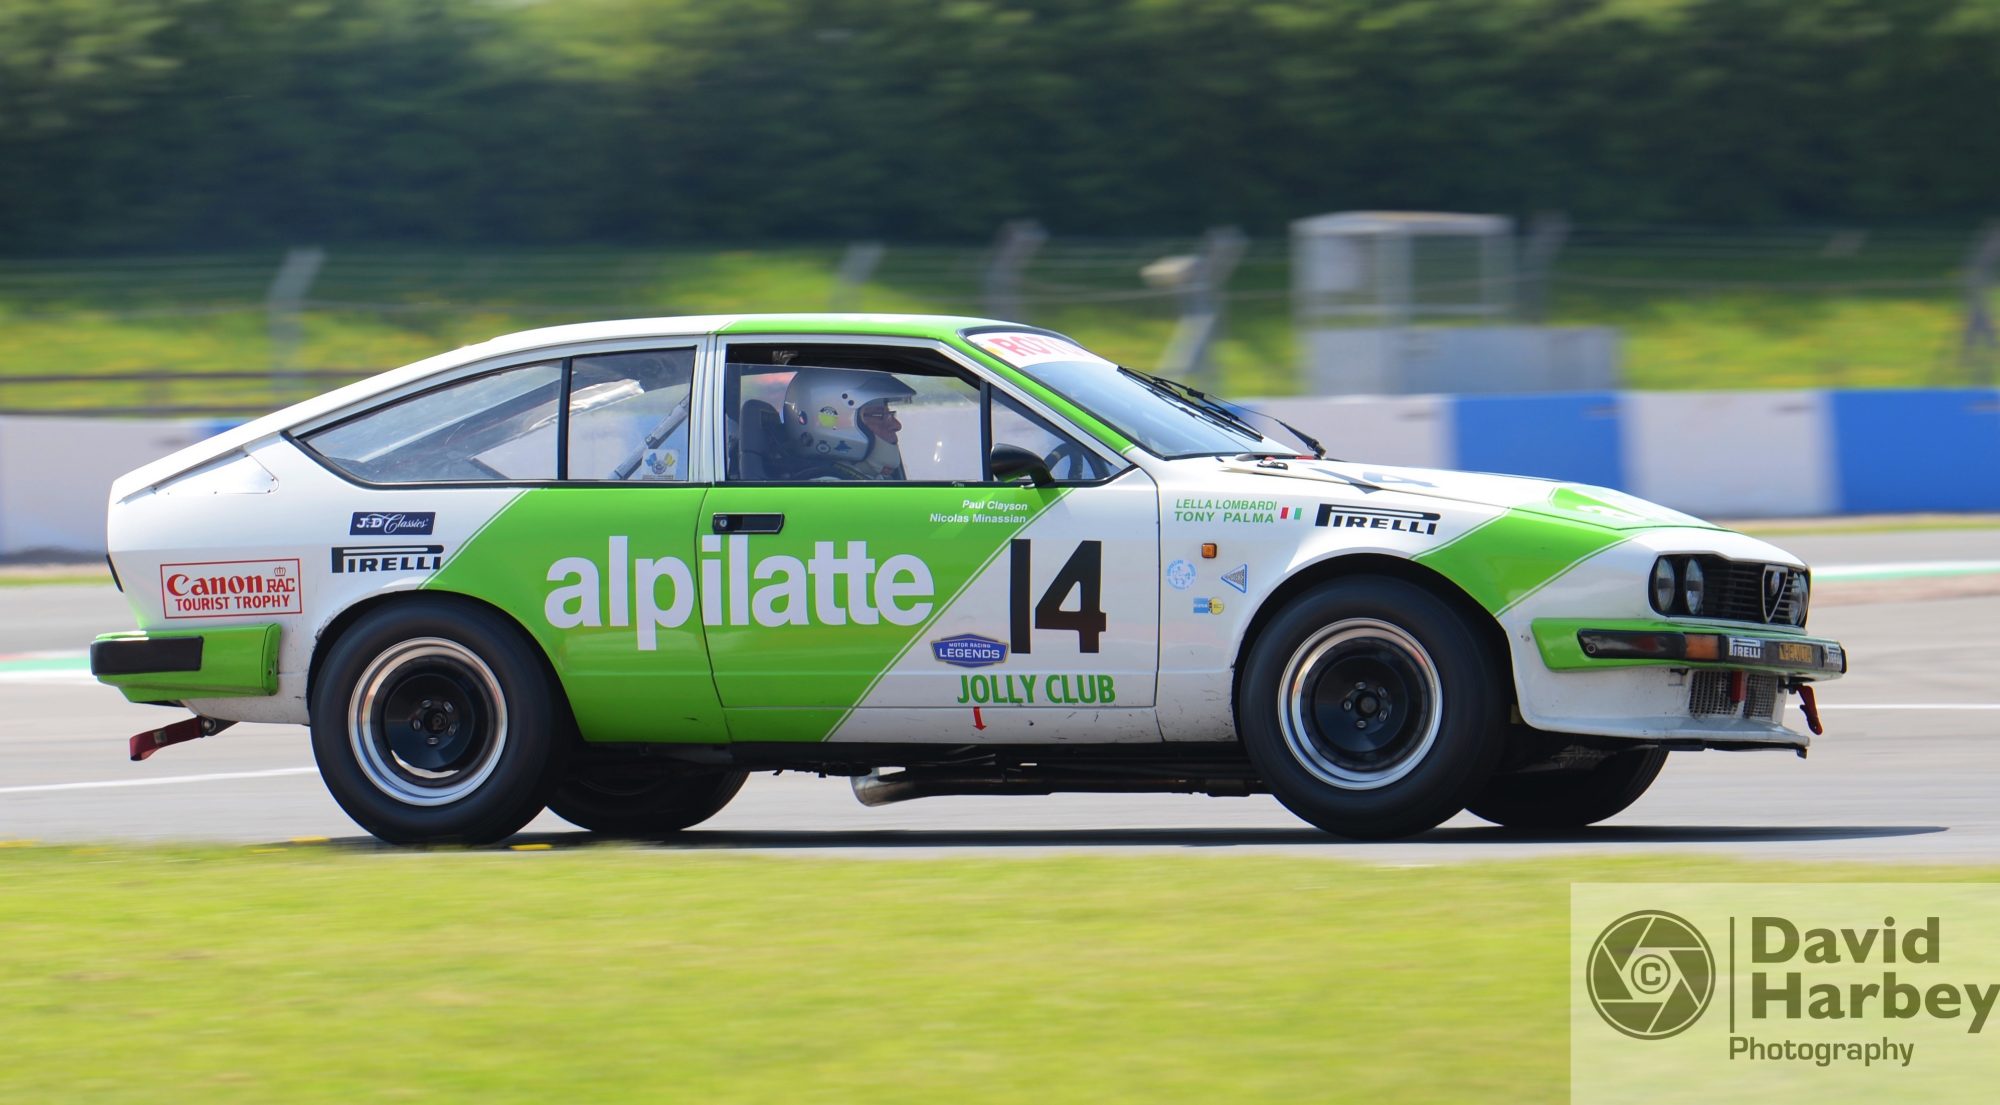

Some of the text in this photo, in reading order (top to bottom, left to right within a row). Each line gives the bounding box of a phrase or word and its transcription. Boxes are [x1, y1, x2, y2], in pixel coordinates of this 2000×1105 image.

[962, 500, 1028, 512] Paul Clayson
[1176, 499, 1277, 511] LELLA LOMBARDI
[930, 513, 1026, 523] Nicolas Minassian
[1174, 511, 1274, 524] TONY PALMA
[1315, 503, 1441, 535] PIRELLI
[331, 545, 444, 573] PIRELLI
[167, 574, 295, 596] Canon RAC
[544, 534, 934, 651] alpilatte
[175, 595, 290, 611] TOURIST TROPHY
[1010, 539, 1107, 654] 14
[939, 648, 1000, 659] LEGENDS
[1728, 637, 1761, 659] PIRELLI
[957, 675, 1116, 704] JOLLY CLUB
